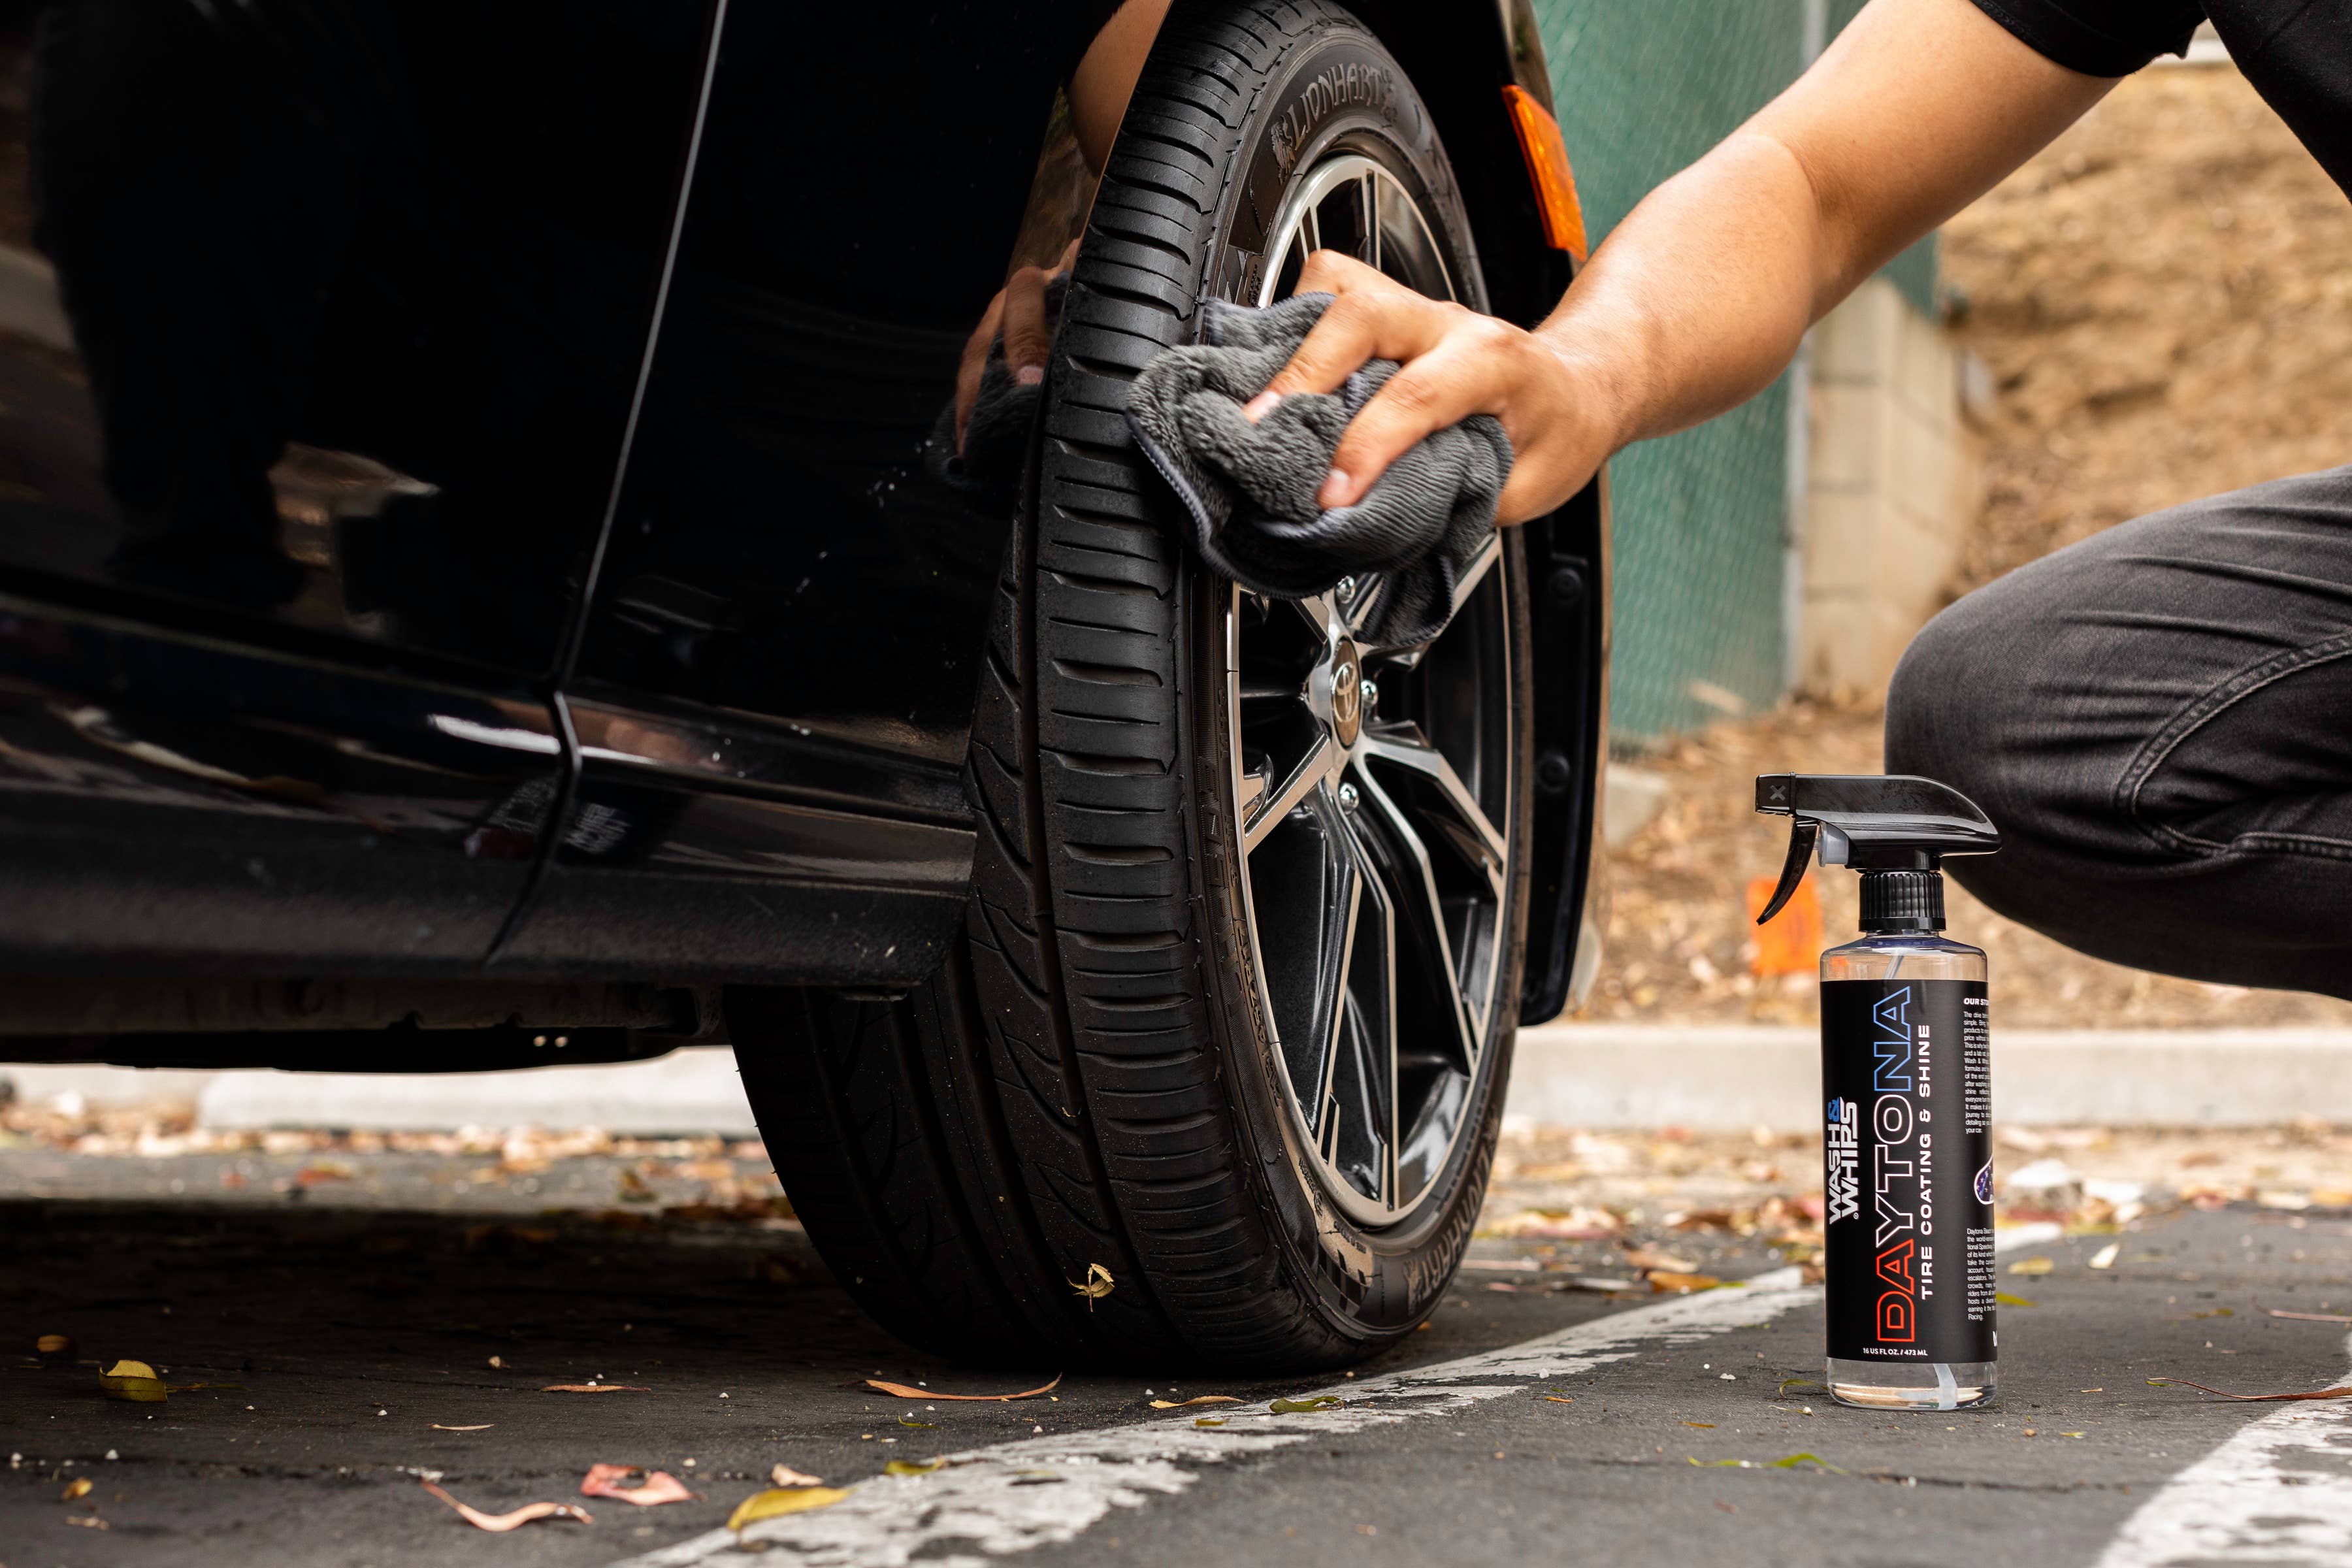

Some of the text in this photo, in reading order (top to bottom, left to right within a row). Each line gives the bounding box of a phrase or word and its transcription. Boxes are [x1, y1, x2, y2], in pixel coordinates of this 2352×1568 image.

[1287, 62, 1382, 151] LIONHART
[1839, 1096, 1859, 1218] WHIPS
[1873, 985, 1916, 1343] DAYTONA
[1918, 1024, 1933, 1299] TIRE COATING & SHINE
